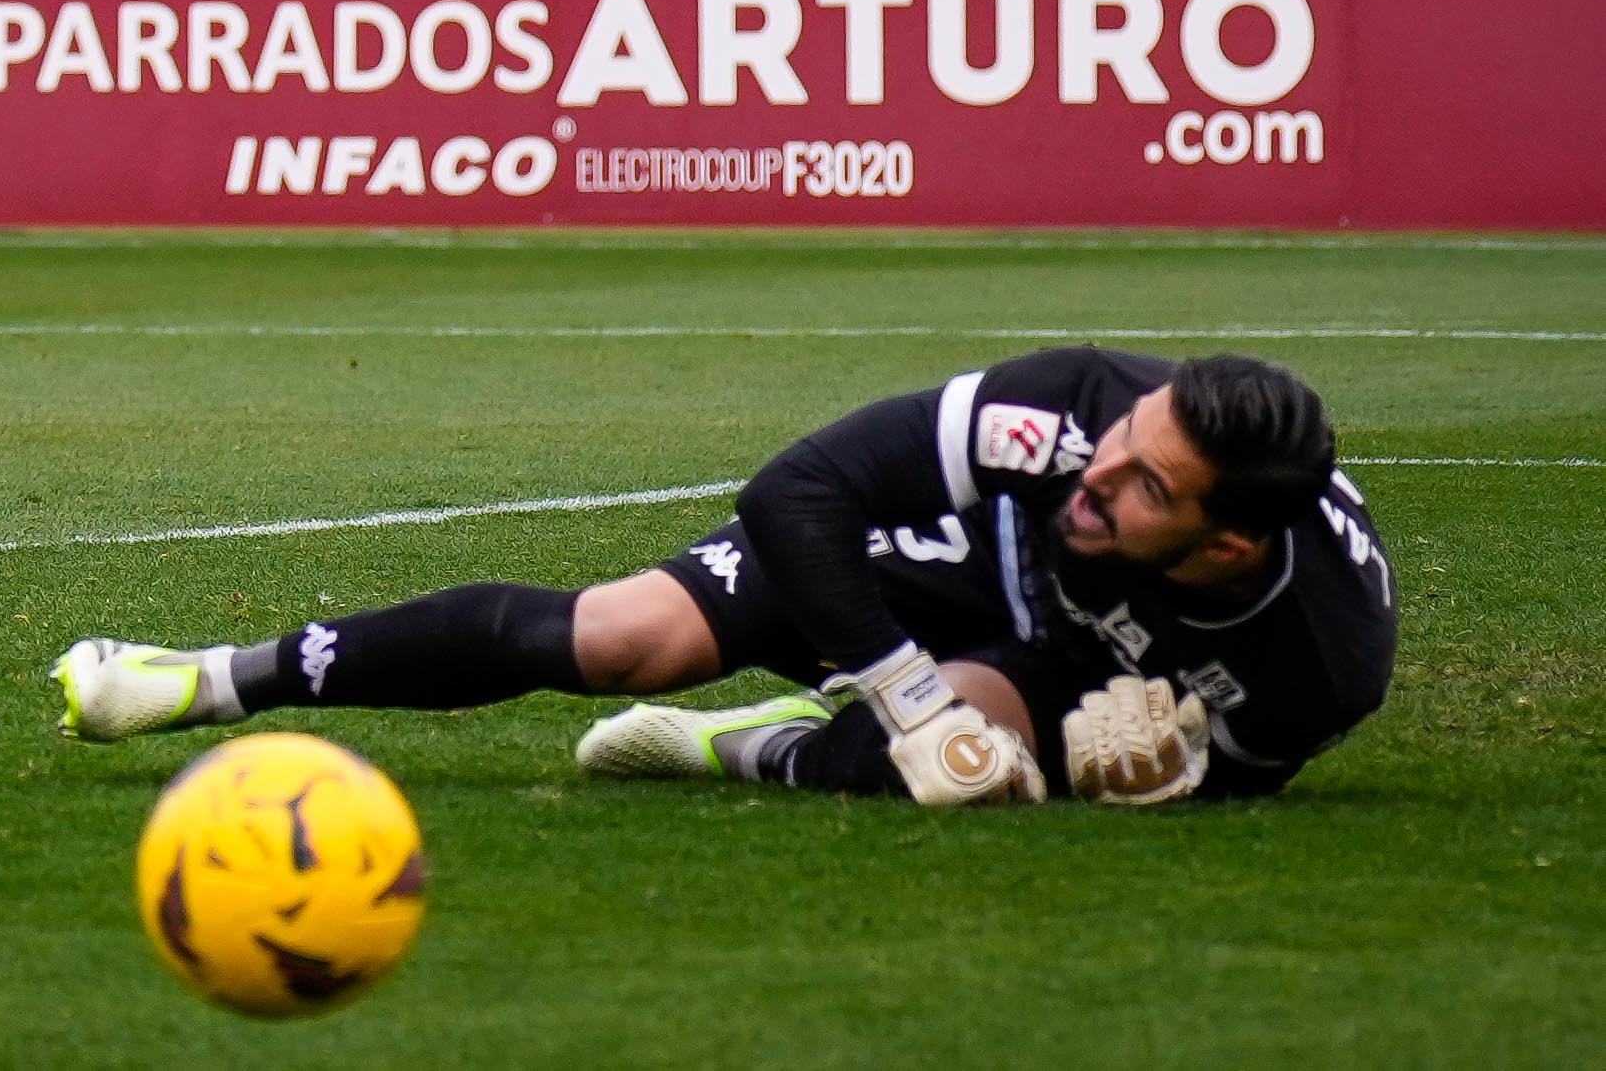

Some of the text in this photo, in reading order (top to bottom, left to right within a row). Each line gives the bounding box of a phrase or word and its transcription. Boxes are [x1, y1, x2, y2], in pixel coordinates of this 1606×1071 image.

[1143, 108, 1326, 165] .com
[576, 146, 784, 194] ELECTROCOUP
[783, 140, 914, 199] F3020
